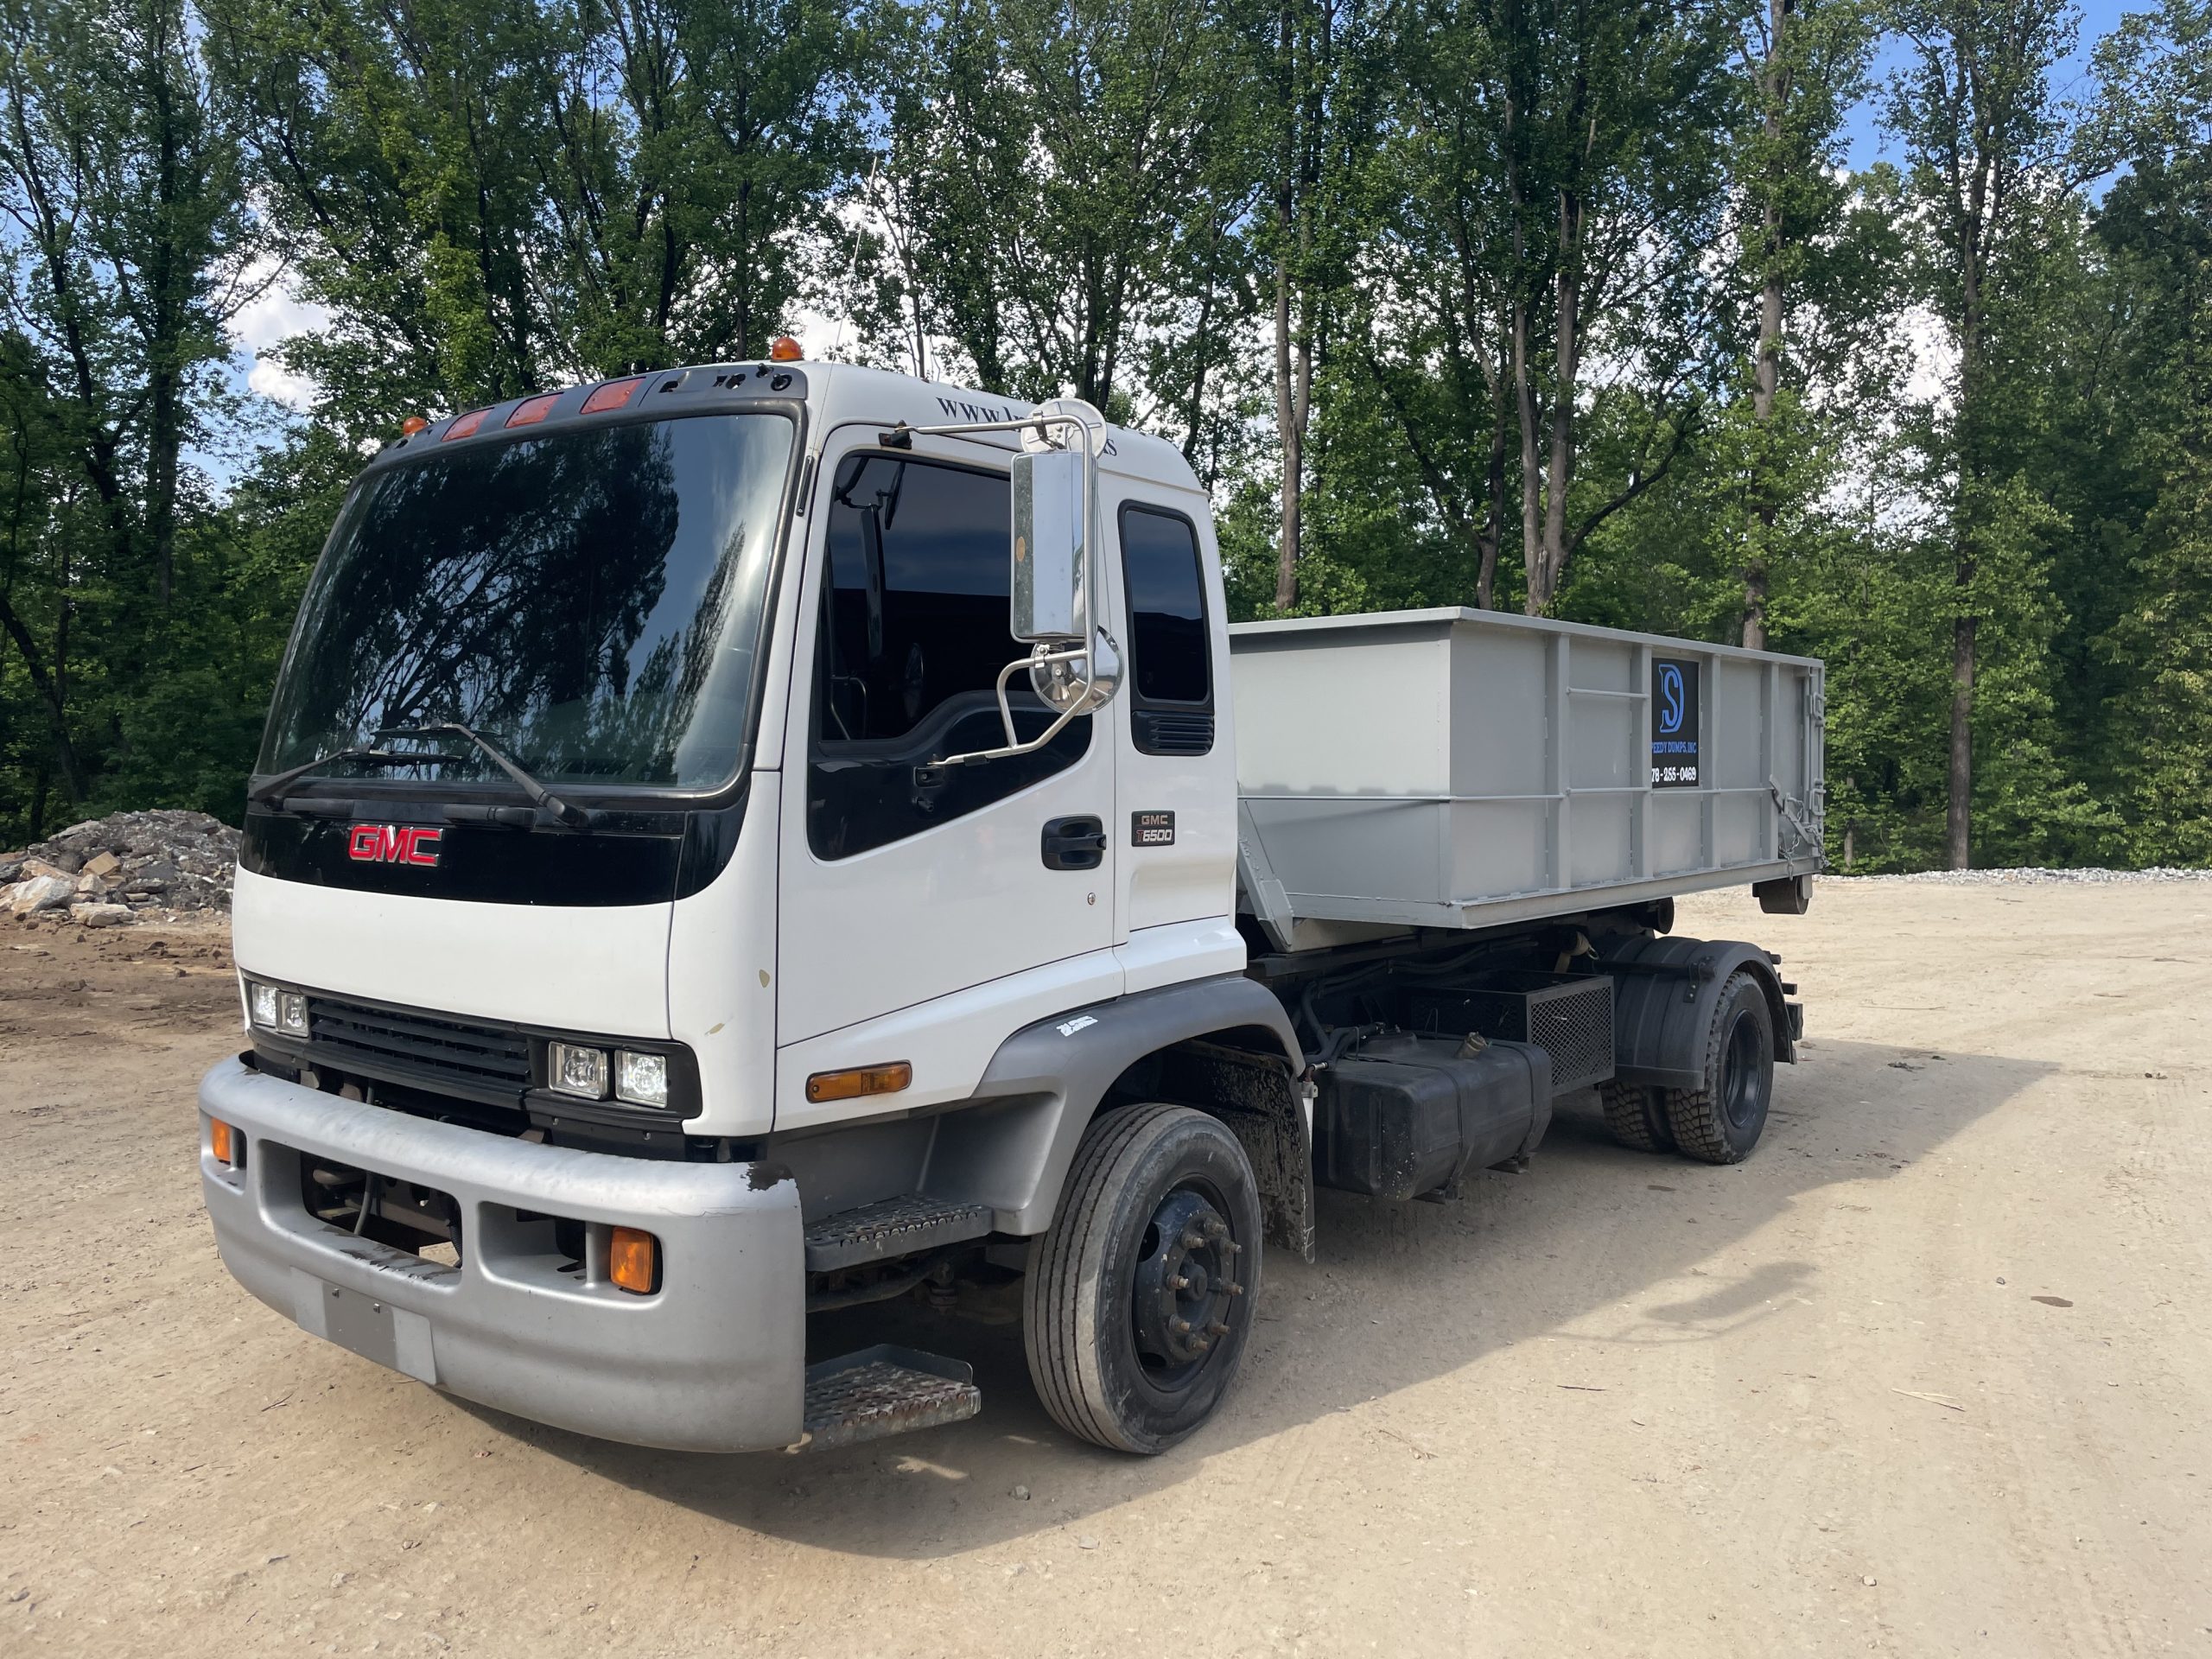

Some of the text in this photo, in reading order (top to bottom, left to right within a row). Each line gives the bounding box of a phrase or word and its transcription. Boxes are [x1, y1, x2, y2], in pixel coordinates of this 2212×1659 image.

[1141, 814, 1168, 825] GMC
[1136, 829, 1173, 842] T6500
[349, 823, 443, 868] GMC
